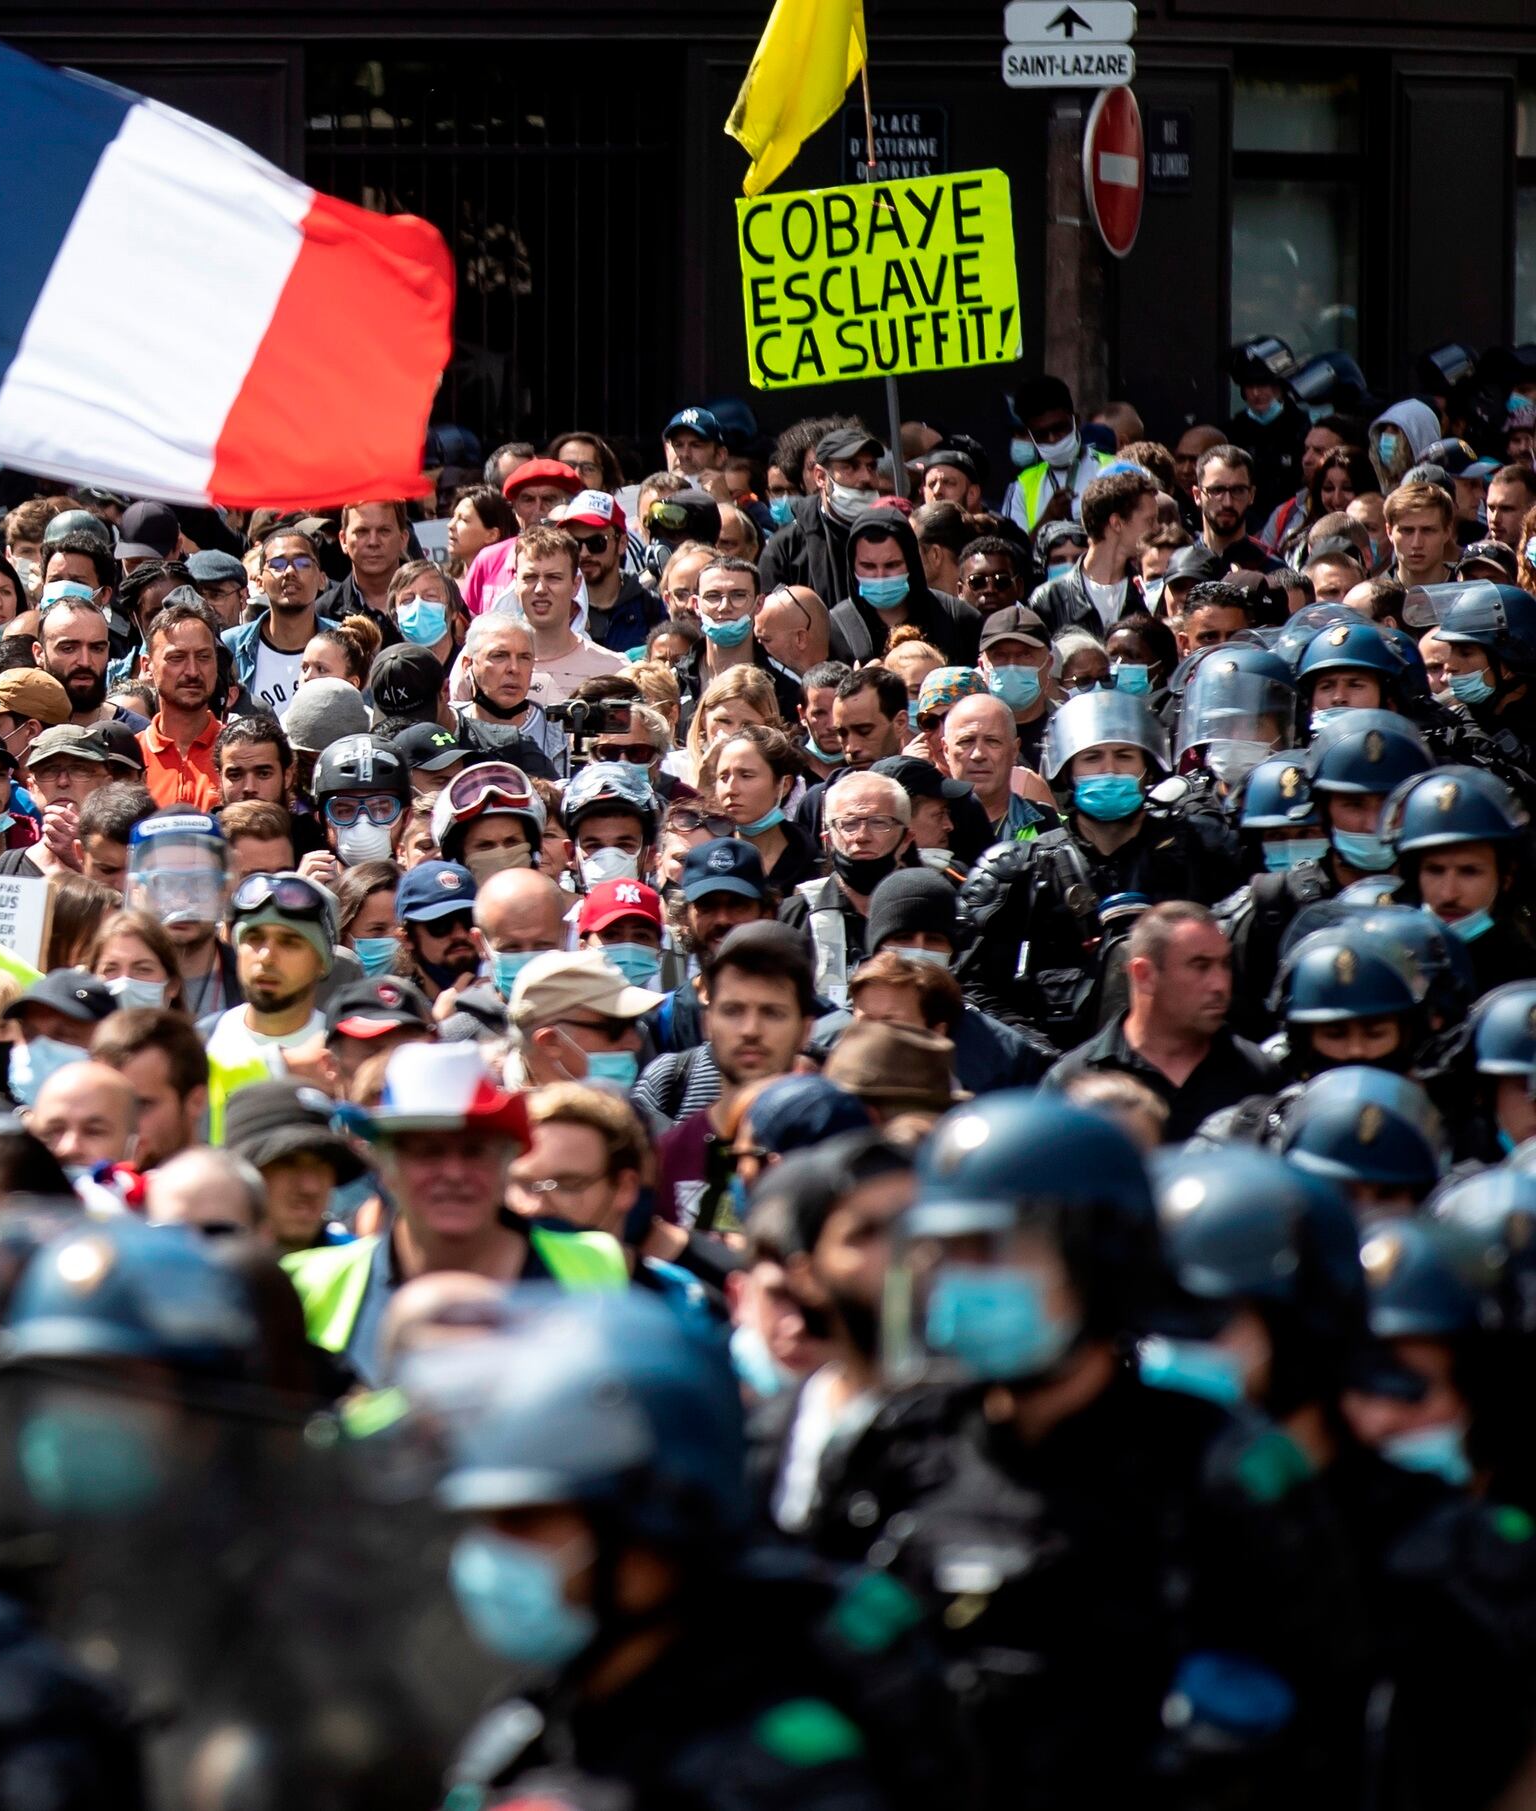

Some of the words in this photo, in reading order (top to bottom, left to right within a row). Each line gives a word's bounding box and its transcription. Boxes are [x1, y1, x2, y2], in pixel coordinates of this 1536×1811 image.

[1007, 54, 1128, 77] SAINT-LAZARE
[742, 180, 985, 265] COBAYE
[750, 250, 983, 327] ESCLAVE
[0, 882, 22, 894] PAS
